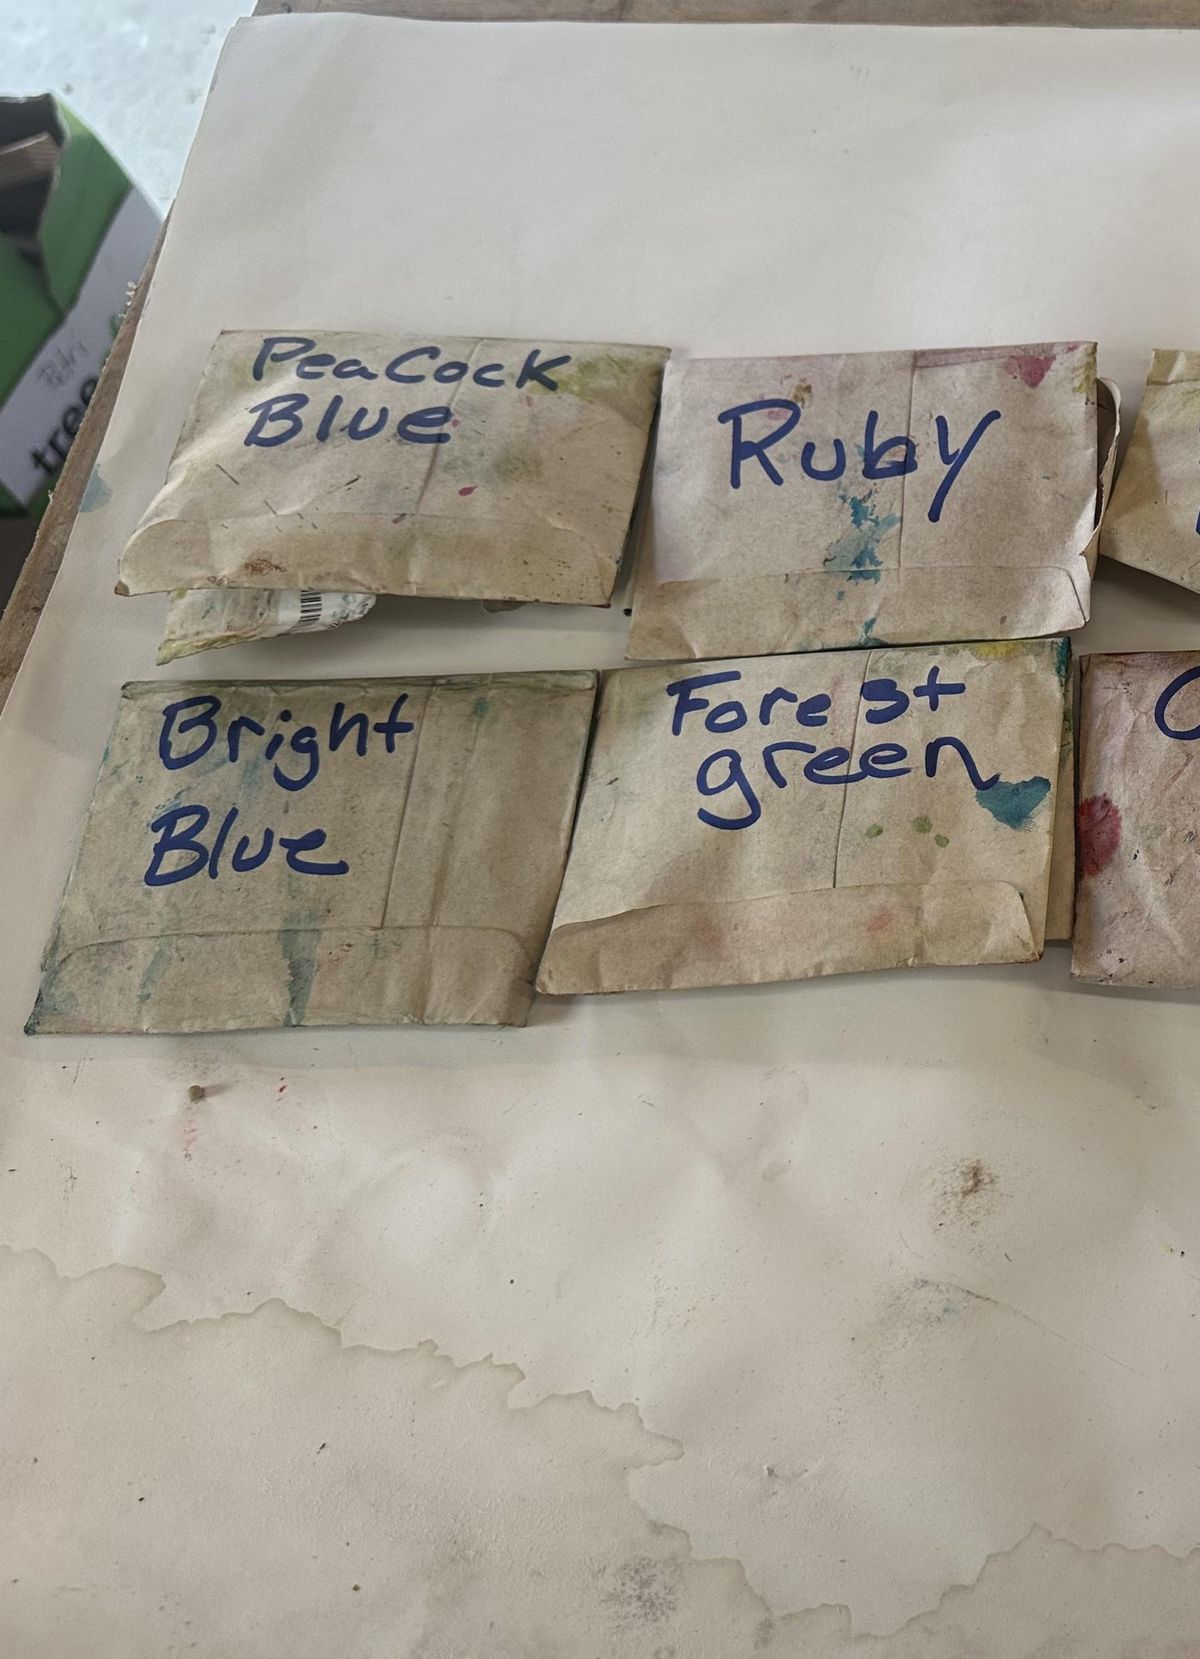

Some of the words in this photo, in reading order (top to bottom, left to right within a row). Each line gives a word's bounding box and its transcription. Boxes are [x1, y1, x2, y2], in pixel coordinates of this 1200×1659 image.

[244, 393, 451, 447] Blue
[718, 398, 1002, 523] Ruby
[159, 692, 414, 792] Bright
[666, 665, 966, 737] Forest
[696, 736, 1001, 831] green
[144, 804, 349, 887] Blue
